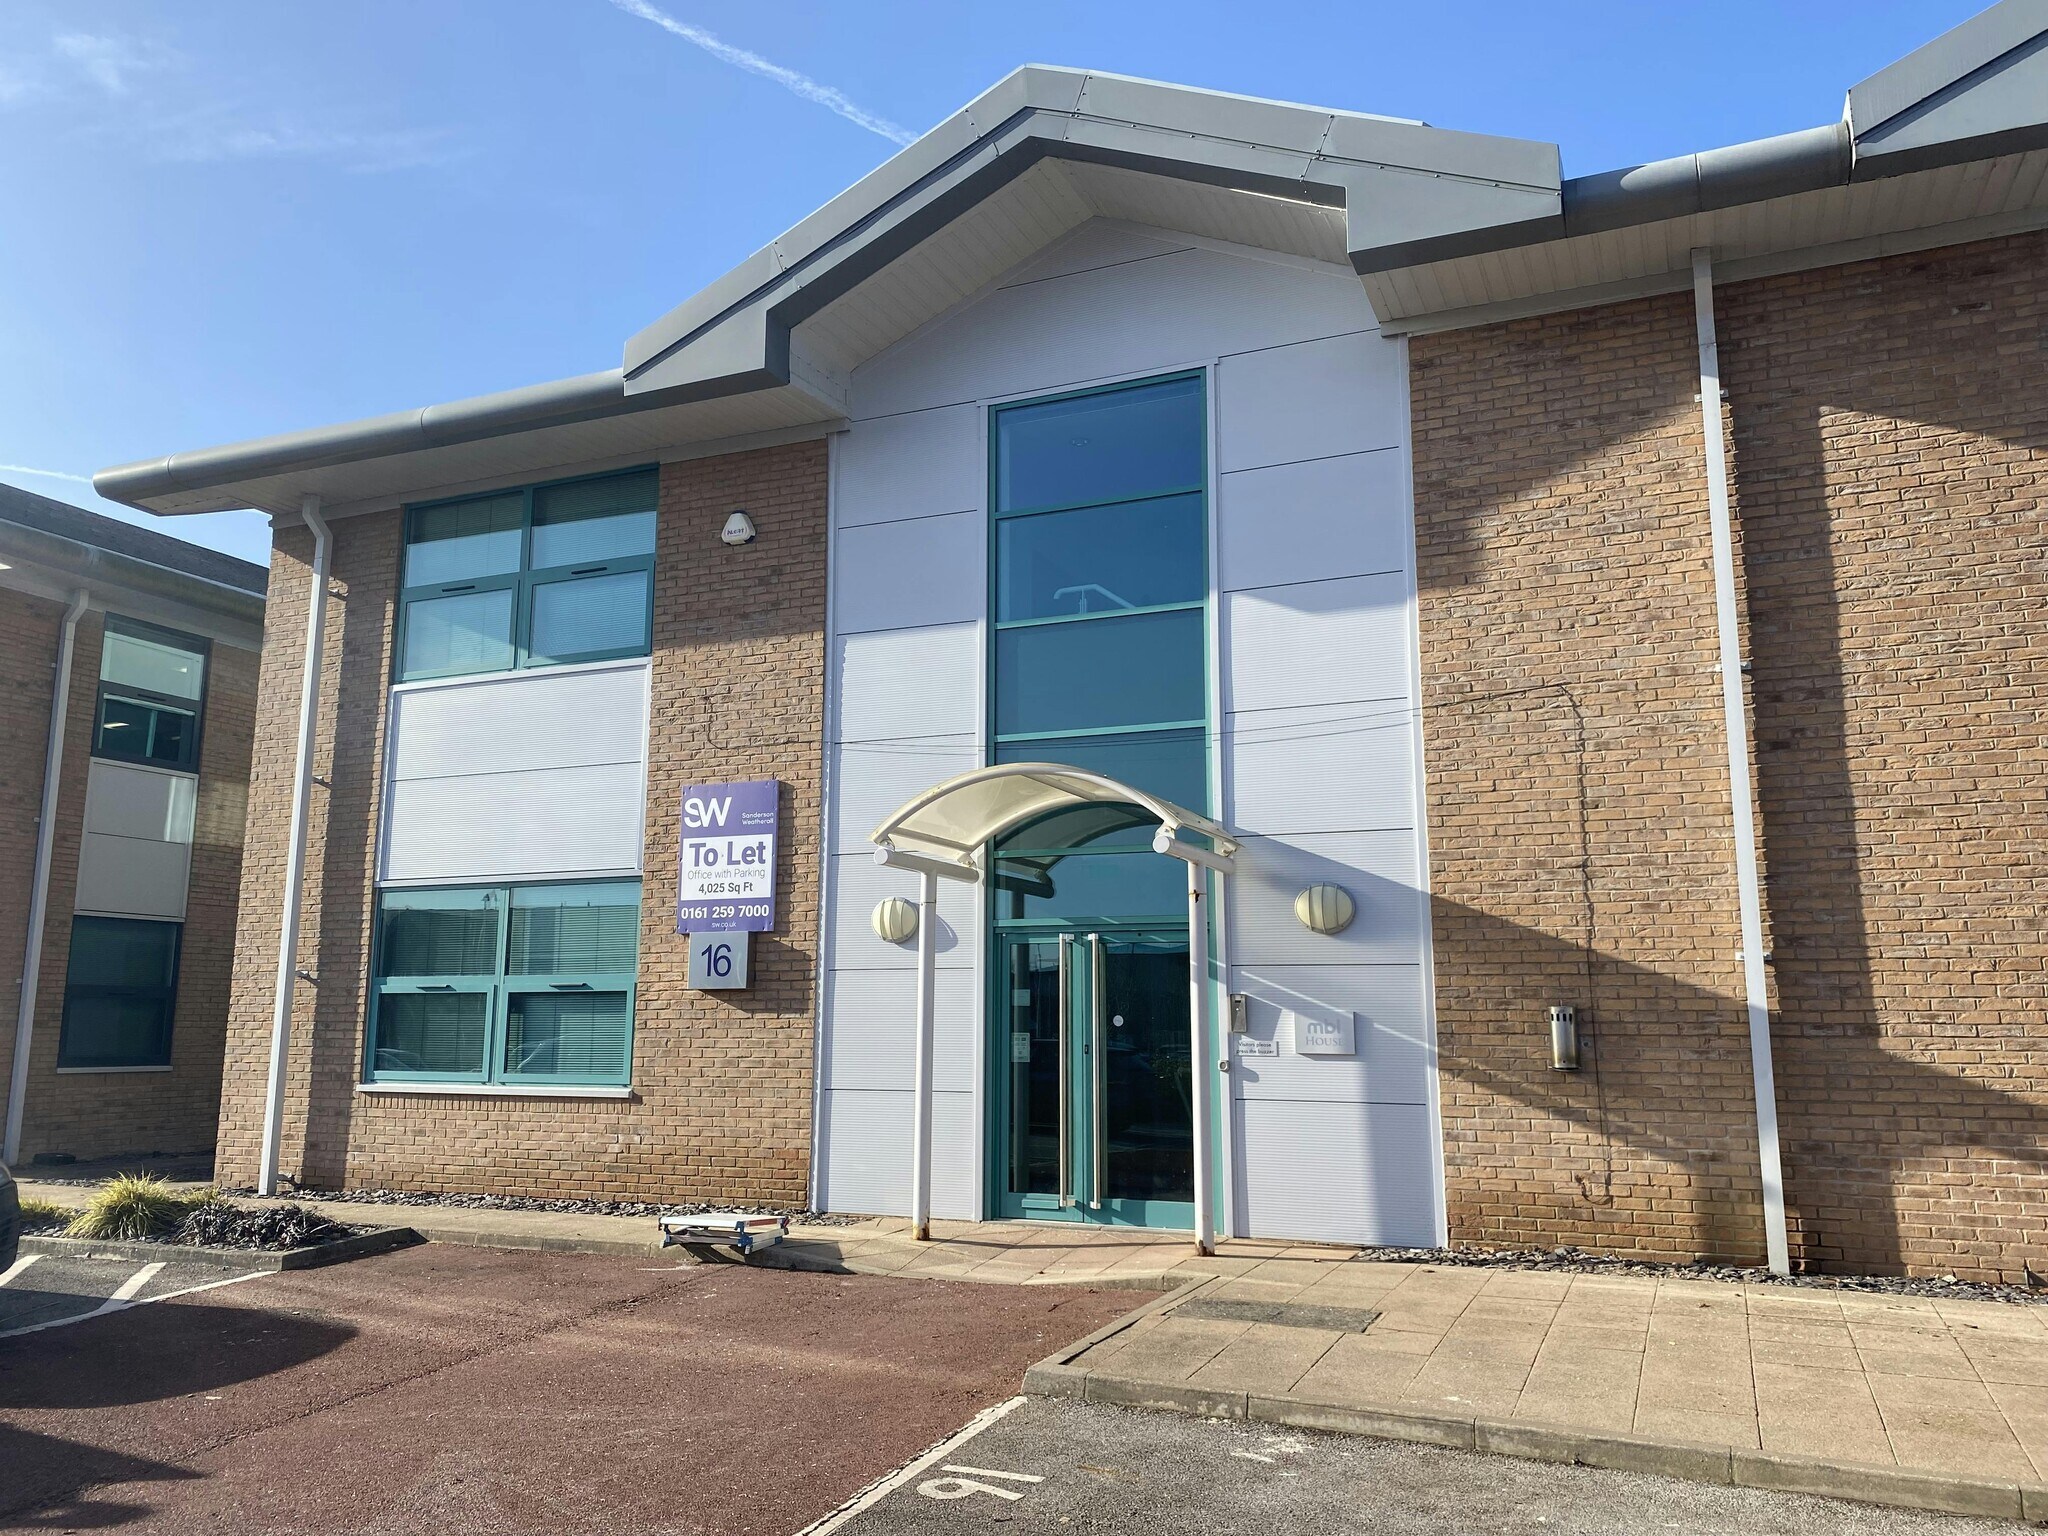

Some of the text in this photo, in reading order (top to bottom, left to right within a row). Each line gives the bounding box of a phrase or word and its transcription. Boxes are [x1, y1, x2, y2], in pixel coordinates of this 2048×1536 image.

[684, 796, 732, 828] SW
[742, 811, 774, 819] Sanderson
[689, 841, 766, 867] To Let
[688, 868, 766, 880] Office with Parking
[698, 881, 754, 895] 4,025 Sq Ft
[681, 904, 770, 919] 0161 259 7000
[711, 920, 737, 928] sw.co.uk
[701, 943, 732, 977] 16
